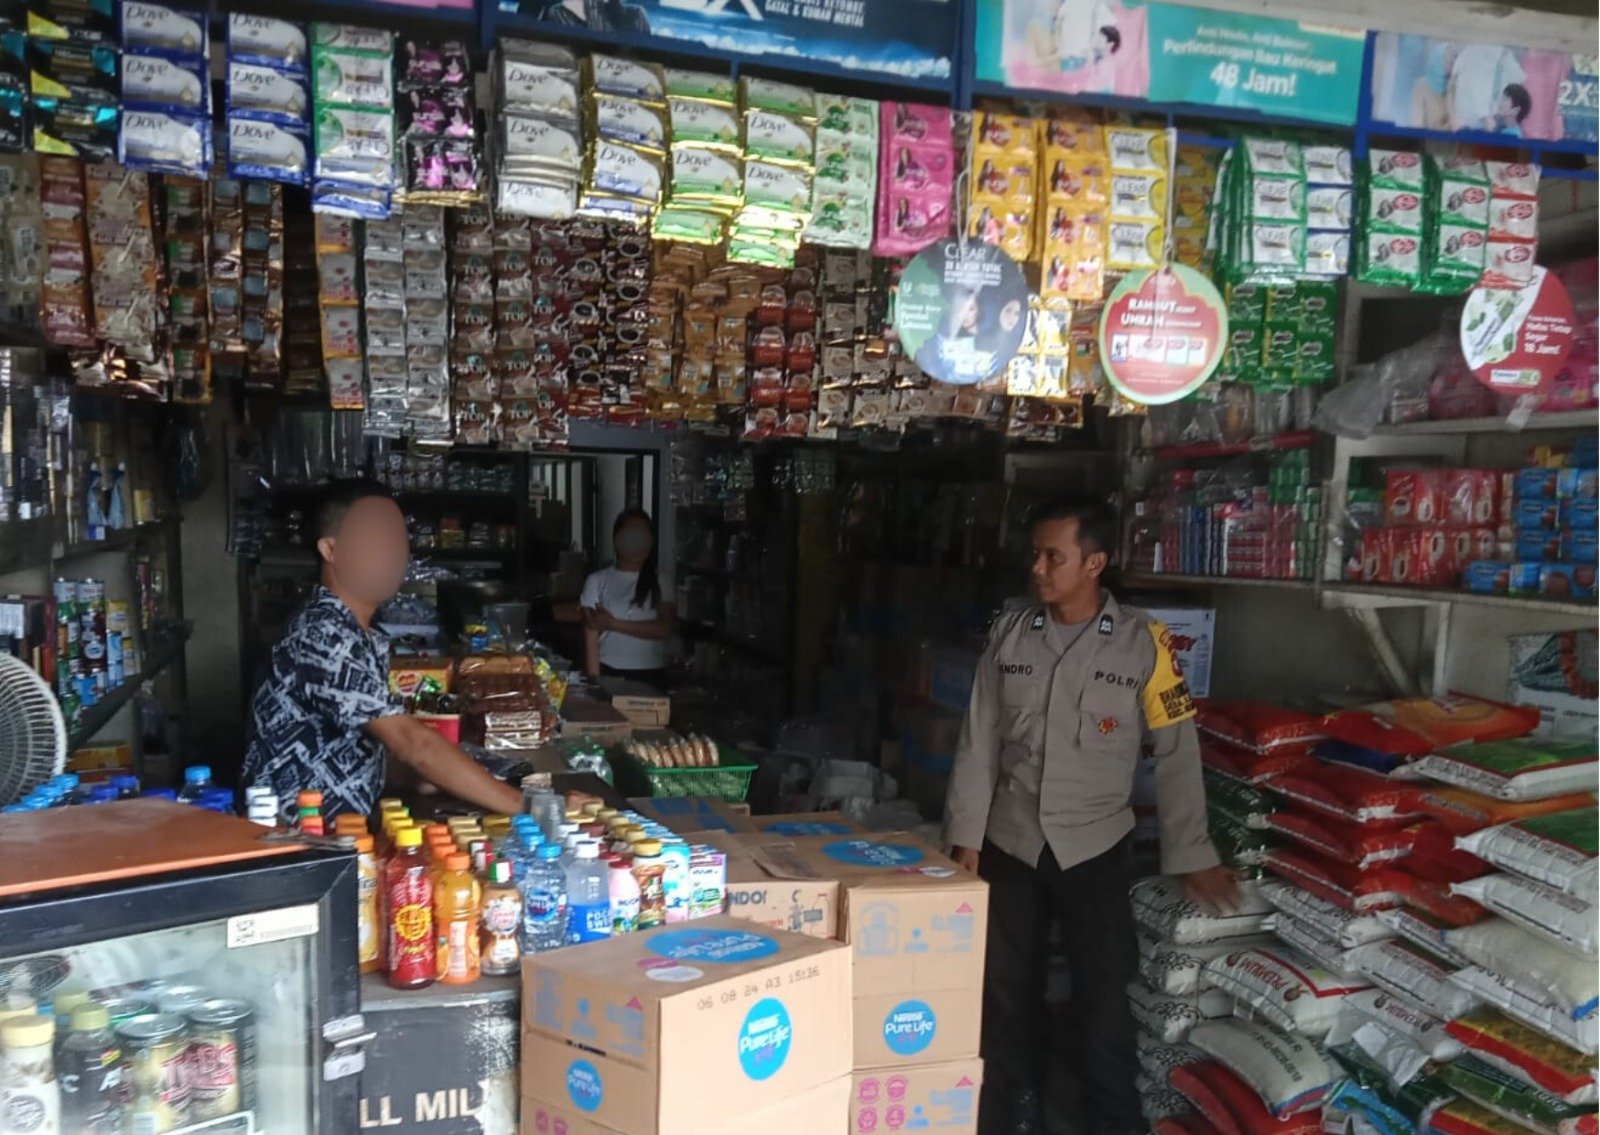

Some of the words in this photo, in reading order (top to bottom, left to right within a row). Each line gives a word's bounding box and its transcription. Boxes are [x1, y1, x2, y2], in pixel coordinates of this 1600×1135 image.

[126, 5, 169, 21] Dove
[232, 13, 275, 29] Dove
[126, 58, 169, 76] Dove
[598, 58, 635, 72] Dove
[233, 69, 276, 86] Dove
[508, 68, 550, 85] Dove
[1209, 62, 1240, 87] 48
[1242, 69, 1297, 96] Jam!
[600, 100, 638, 114] Dove
[674, 100, 710, 116] Dove
[126, 114, 168, 130] Dove
[510, 121, 550, 136] Dove
[751, 115, 787, 132] Dove
[233, 124, 275, 140] Dove
[600, 147, 637, 163] Dove
[676, 150, 712, 167] Dove
[748, 165, 784, 182] Dove
[462, 214, 487, 225] TOP
[945, 243, 986, 260] CLEAR
[503, 262, 527, 272] TOP
[534, 255, 557, 266] TOP
[464, 265, 489, 276] TOP
[504, 312, 528, 322] TOP
[534, 305, 556, 315] TOP
[464, 314, 489, 325] TOP
[507, 361, 531, 371] TOP
[510, 409, 533, 419] TOP
[1094, 671, 1138, 688] POLRI
[1240, 957, 1290, 991] PREMIUM
[697, 996, 714, 1010] 06
[721, 990, 736, 1004] 08
[789, 965, 820, 984] 15:36
[885, 1022, 912, 1035] Pure
[913, 1019, 934, 1036] Life
[739, 1033, 770, 1055] Pure
